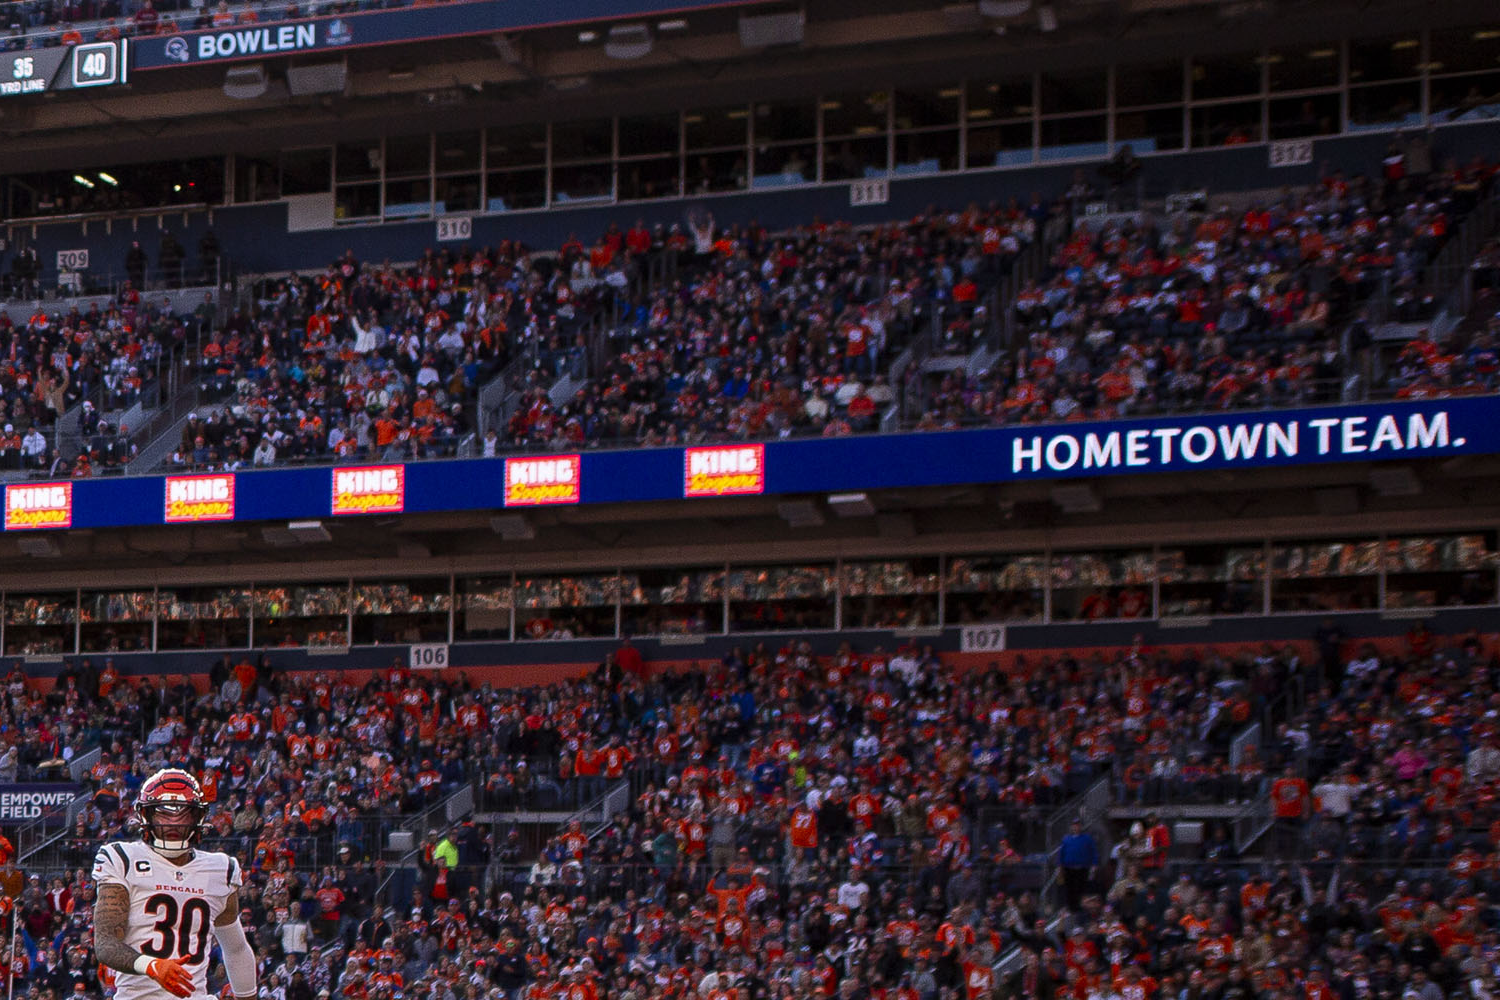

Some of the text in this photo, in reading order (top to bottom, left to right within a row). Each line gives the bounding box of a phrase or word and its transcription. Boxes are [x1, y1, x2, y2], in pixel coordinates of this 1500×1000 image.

[198, 24, 316, 59] BOWLEN
[13, 57, 34, 78] 35
[82, 53, 106, 76] 40
[23, 79, 45, 92] LINE
[437, 220, 469, 238] 310
[60, 251, 87, 268] 309
[1012, 411, 1468, 473] HOMETOWN TEAM.
[690, 448, 758, 475] KING
[337, 468, 399, 494] KING
[509, 459, 575, 485] KING
[9, 486, 67, 509] KING
[169, 478, 229, 501] KING
[9, 507, 67, 527] Soopers
[169, 499, 230, 519] Soopers
[967, 629, 1001, 648] 107
[414, 647, 445, 665] 106
[2, 793, 75, 806] EMPOWER
[1, 805, 41, 818] FIELD
[135, 861, 150, 873] C
[155, 884, 204, 895] BENGALS
[140, 893, 211, 966] 30
